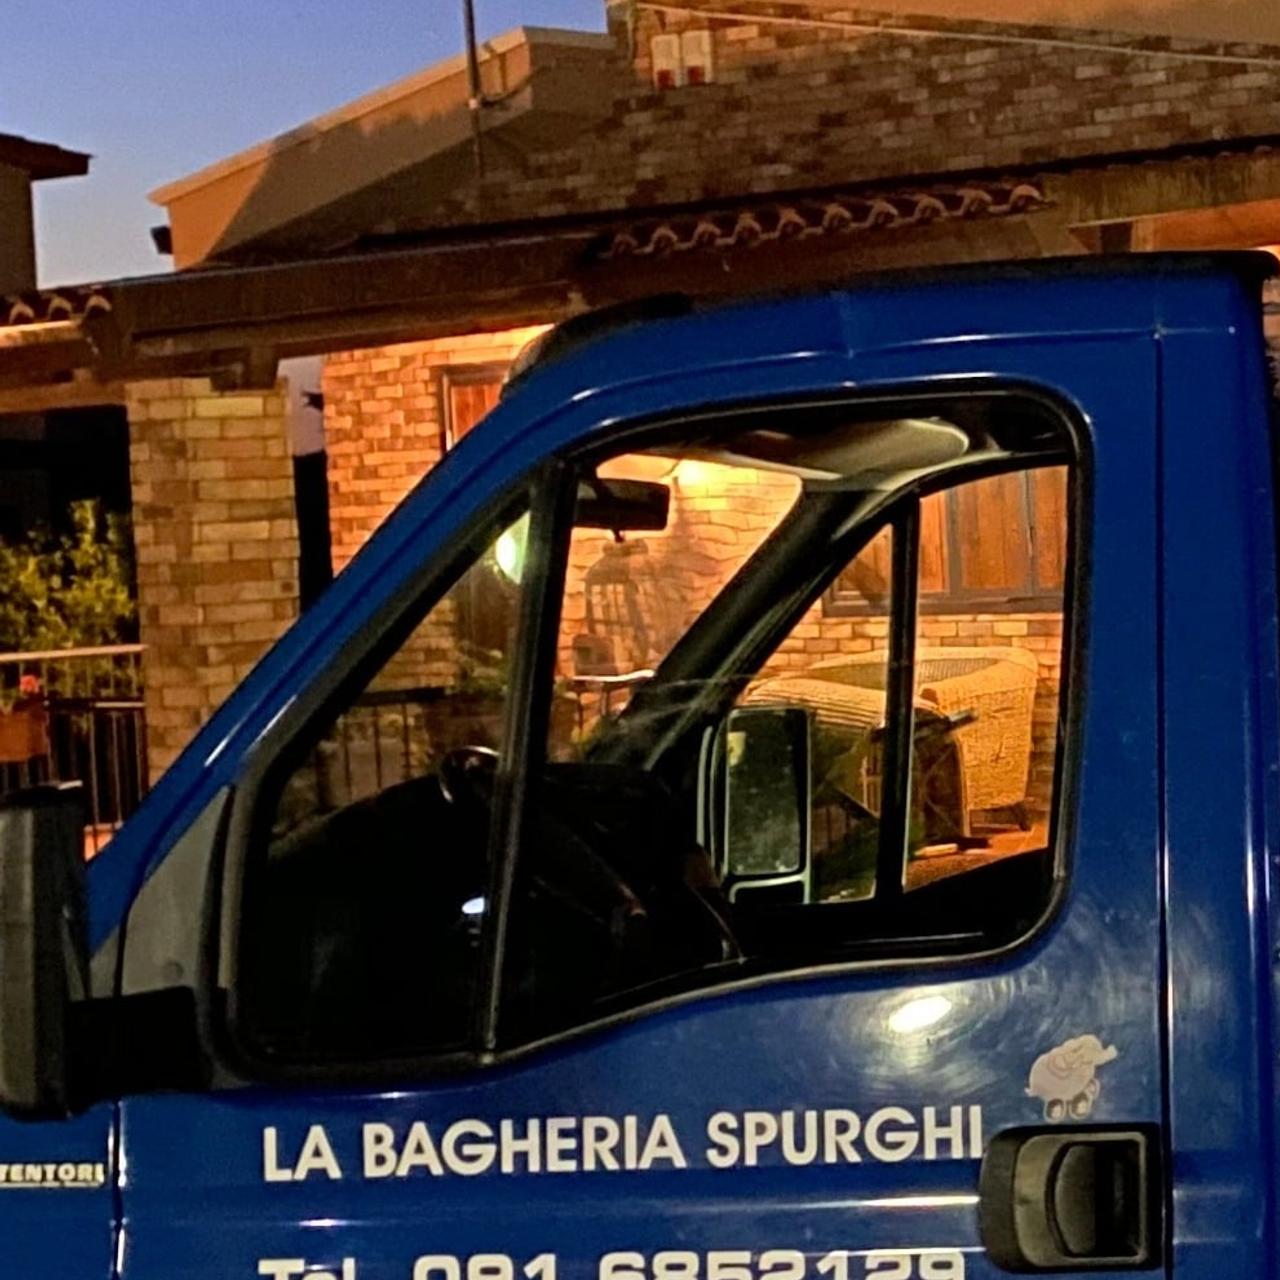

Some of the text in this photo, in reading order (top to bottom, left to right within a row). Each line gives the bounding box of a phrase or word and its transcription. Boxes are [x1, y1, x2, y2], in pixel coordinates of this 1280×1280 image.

[264, 1105, 982, 1181] LA BAGHERIA SPURGHI
